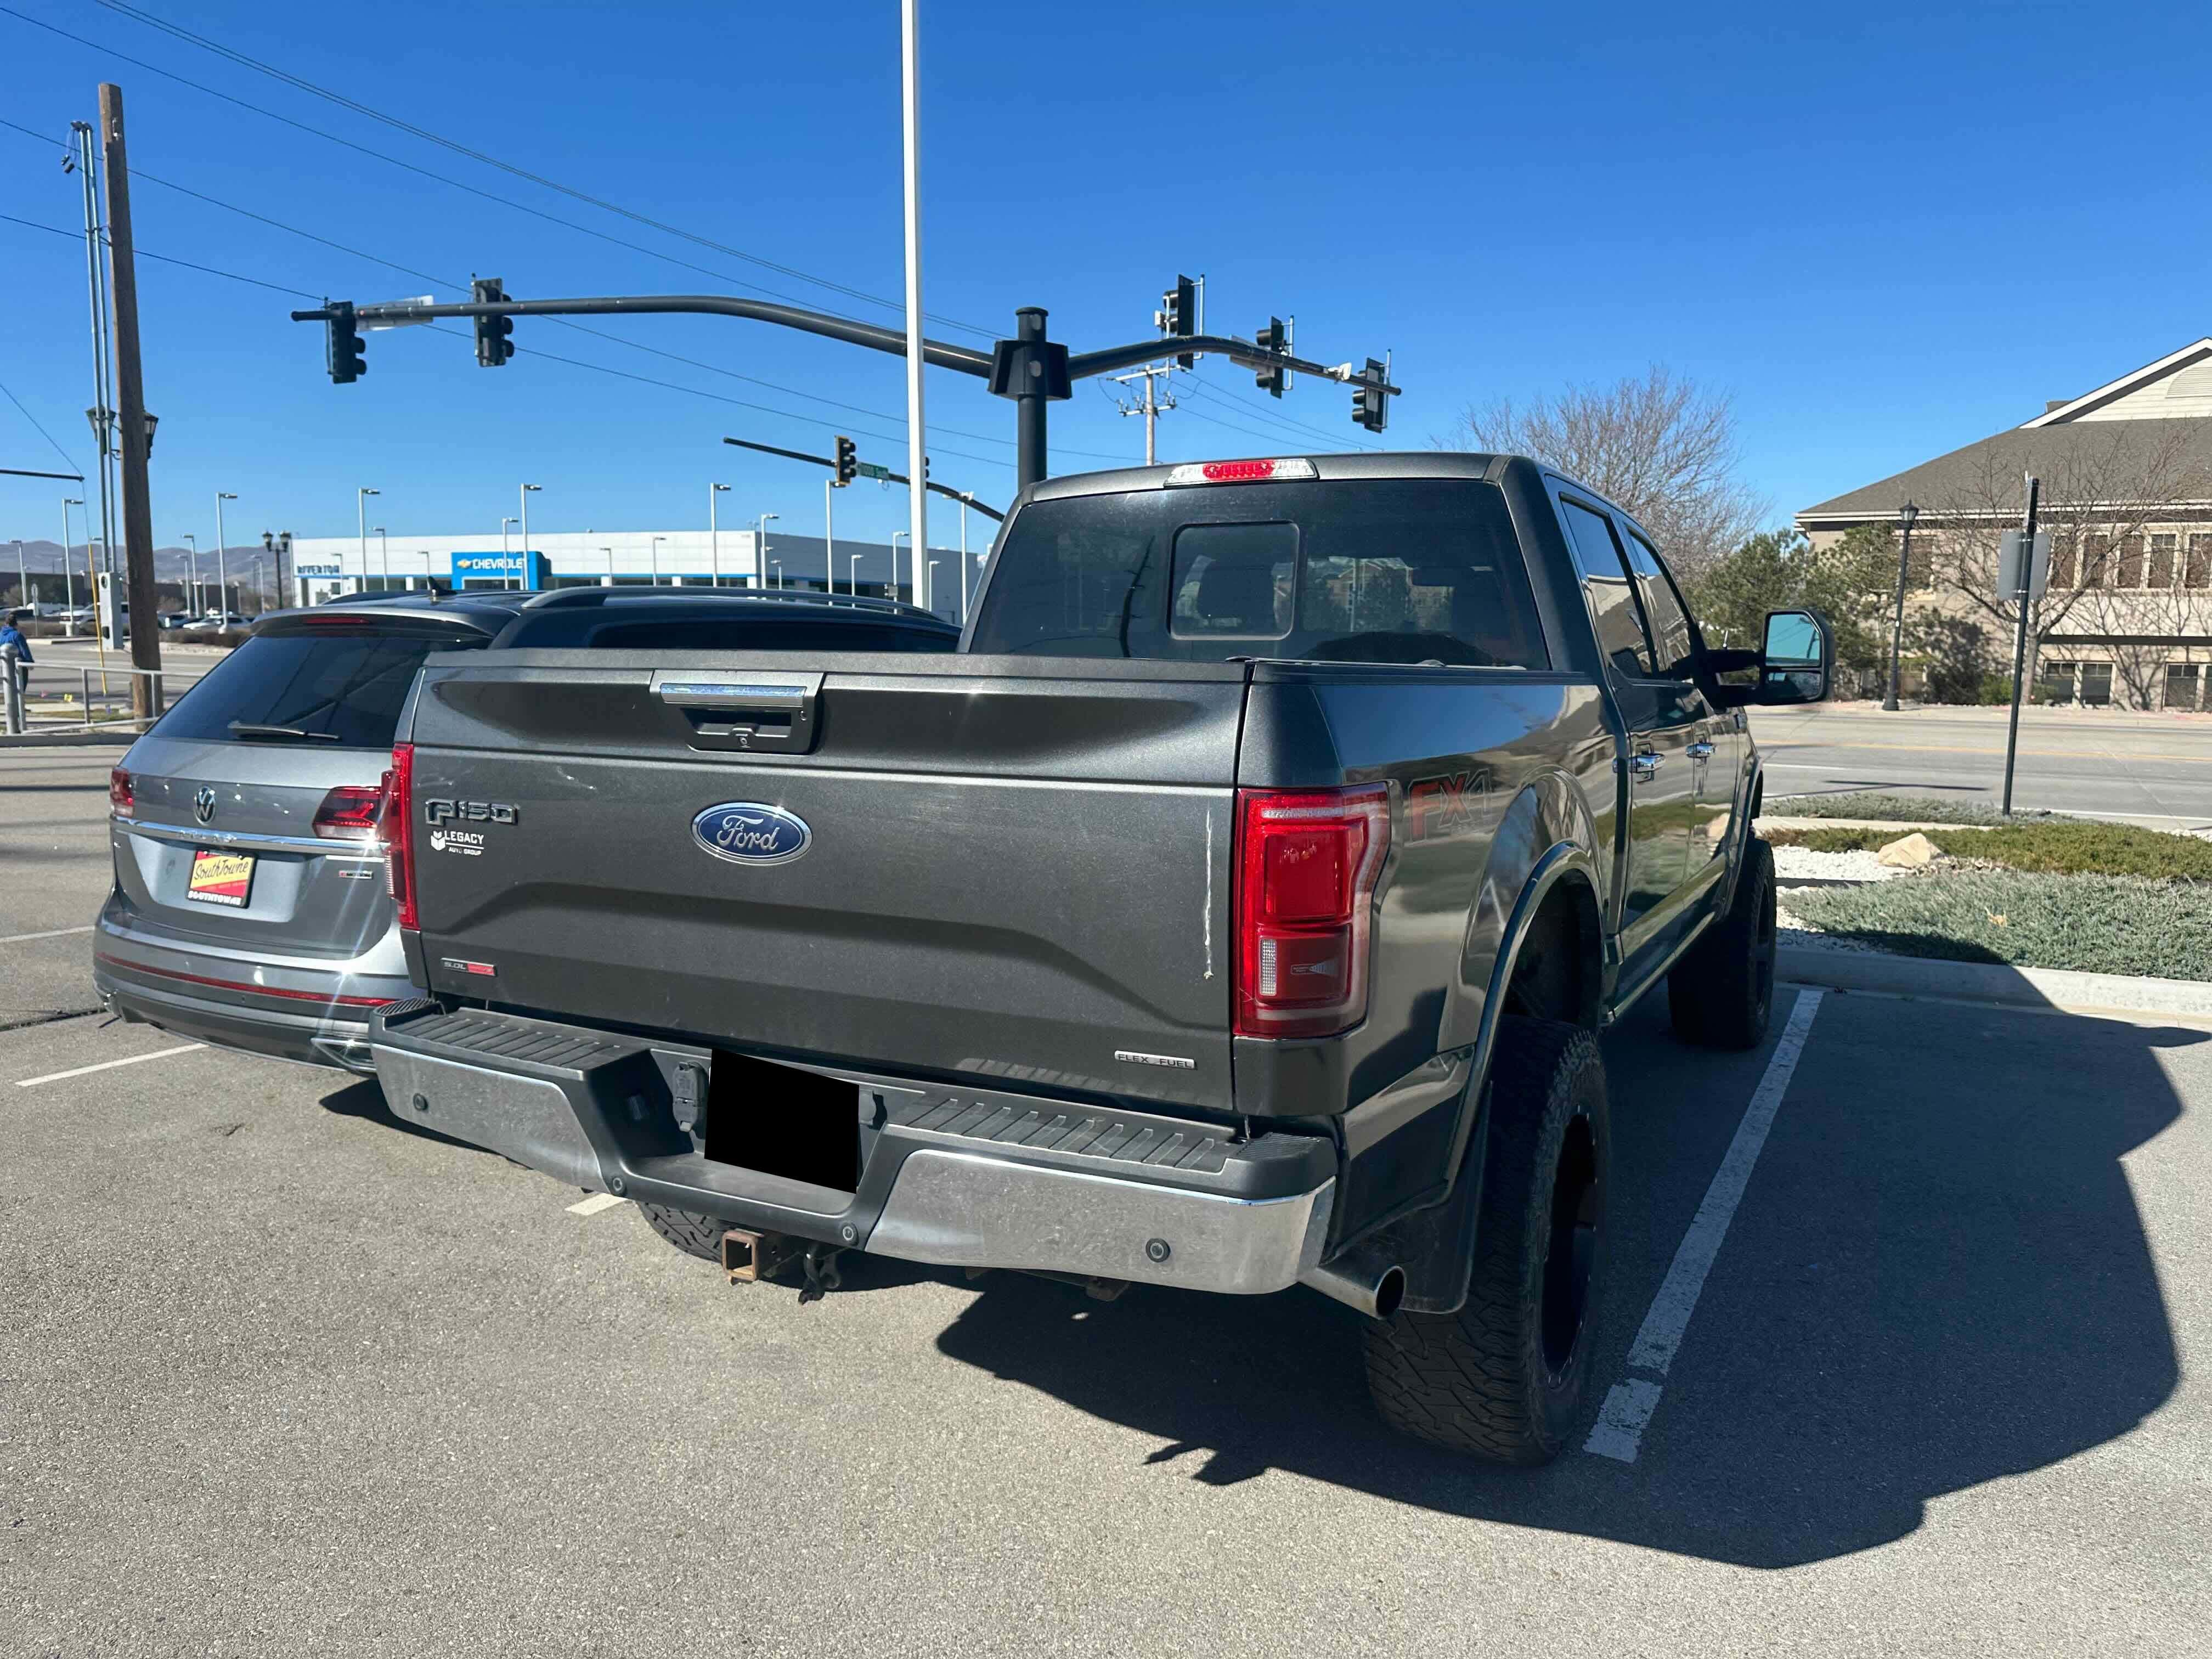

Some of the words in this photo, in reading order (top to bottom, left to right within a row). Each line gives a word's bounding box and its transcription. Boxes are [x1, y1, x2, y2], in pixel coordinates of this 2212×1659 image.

[472, 558, 528, 569] CHEVROLE
[444, 830, 484, 845] LEGACY
[716, 815, 780, 850] Ford
[194, 859, 249, 880] SouthTowne
[1118, 1053, 1149, 1063] FLEX
[1160, 1058, 1192, 1068] FUEL
